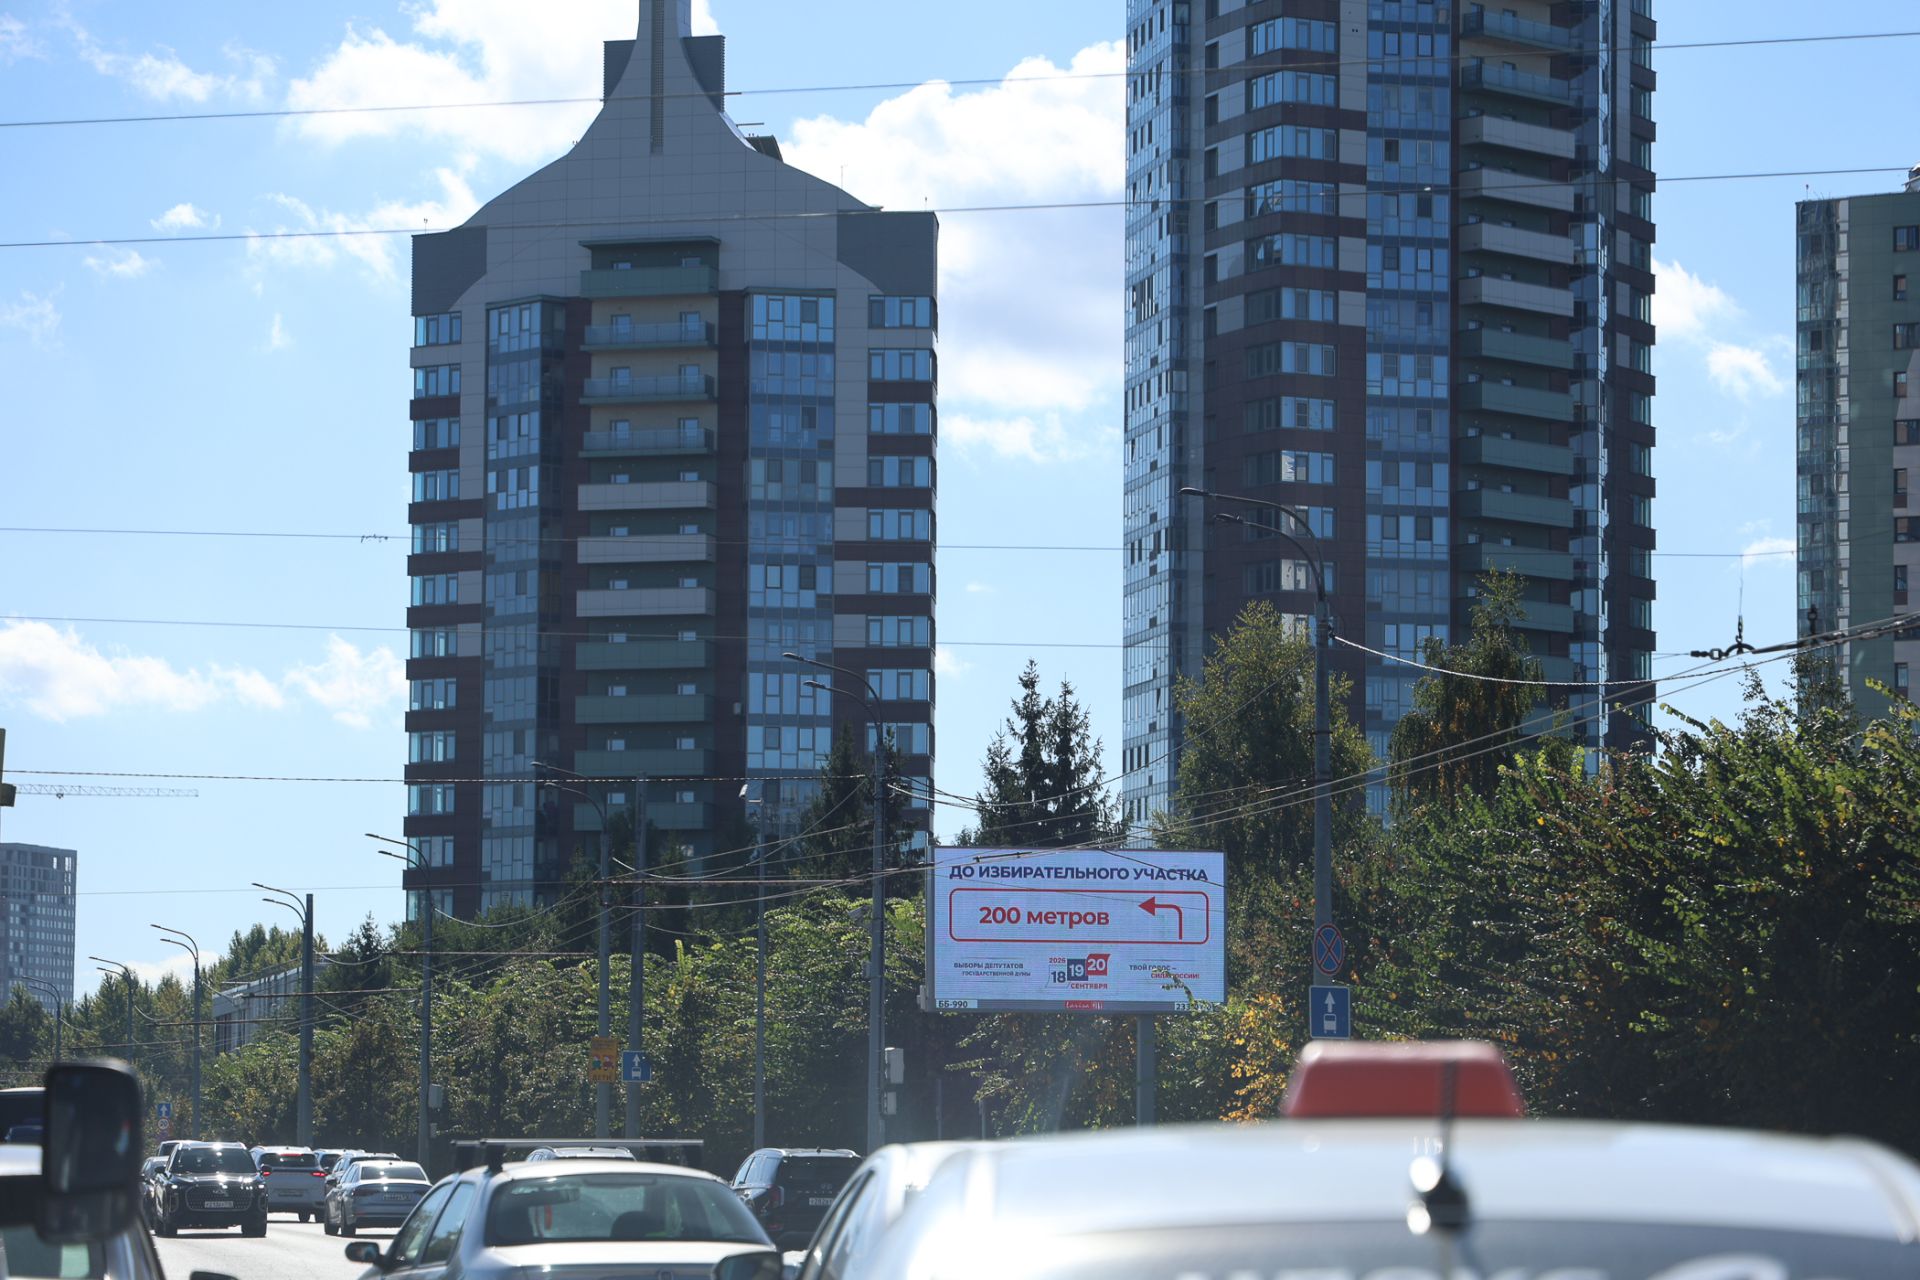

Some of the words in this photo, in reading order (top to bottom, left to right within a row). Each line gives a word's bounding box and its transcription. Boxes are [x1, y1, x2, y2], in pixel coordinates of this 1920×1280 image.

[949, 865, 975, 880] ДО
[978, 865, 1130, 880] ИЗБИРАТЕЛЬНОГО
[1133, 867, 1208, 881] УЧАСТКА
[979, 907, 1021, 924] 200
[1027, 910, 1109, 929] метров
[984, 962, 1024, 970] ДЕПУТАТОВ
[1070, 964, 1085, 977] 19
[1087, 958, 1106, 971] 20
[1051, 970, 1067, 984] 18
[1070, 982, 1108, 990] СЕНТЯБРЯ
